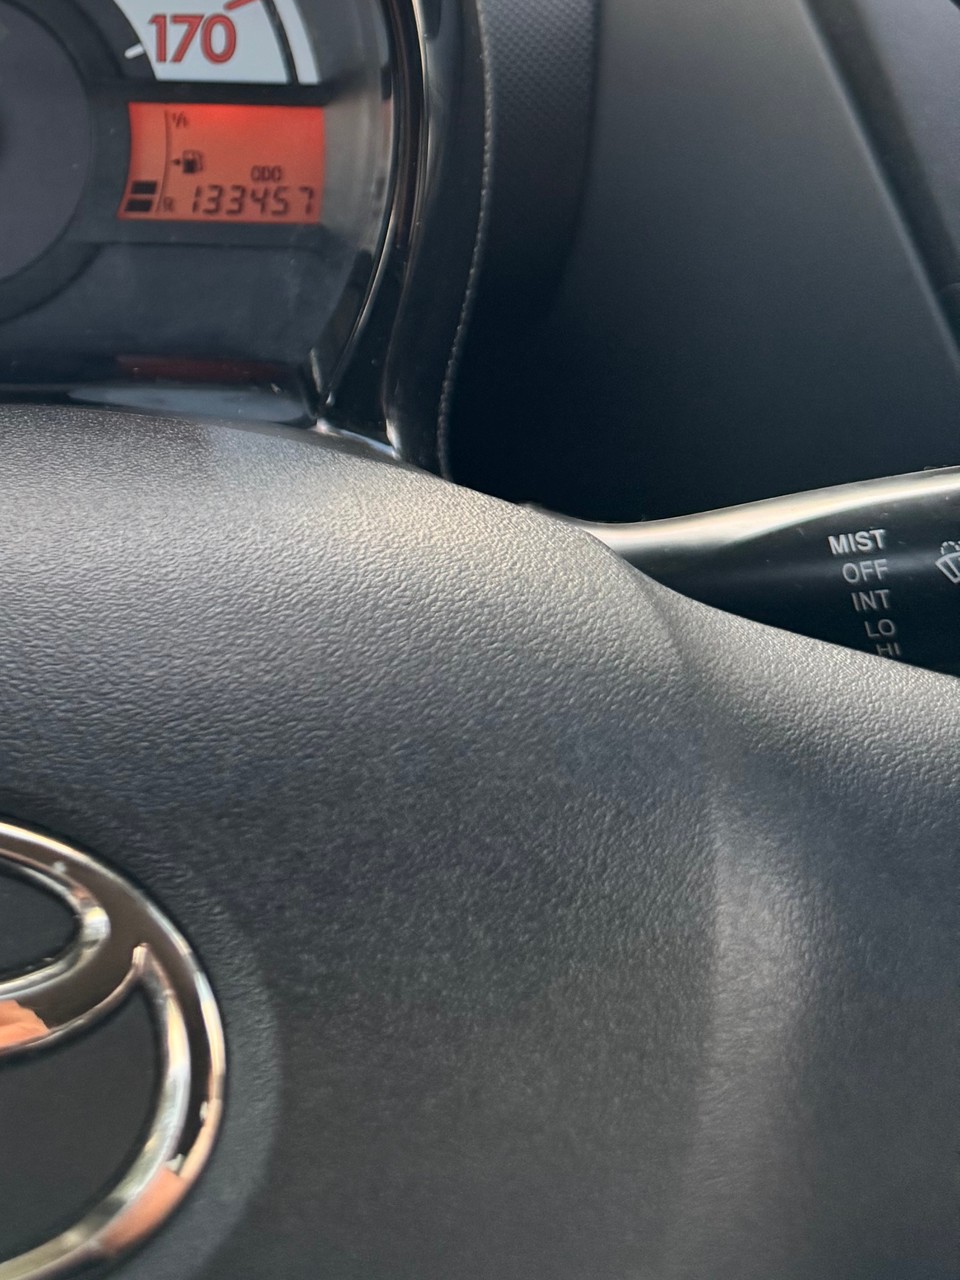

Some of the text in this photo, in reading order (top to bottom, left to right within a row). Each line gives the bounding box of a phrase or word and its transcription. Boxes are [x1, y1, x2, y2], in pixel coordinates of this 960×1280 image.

[147, 13, 238, 65] 170
[250, 165, 282, 182] ODO
[191, 184, 315, 217] 133457
[828, 529, 886, 555] MIST
[842, 558, 888, 584] OFF
[851, 589, 890, 611] INT
[864, 618, 896, 638] LO
[875, 642, 901, 657] HI
